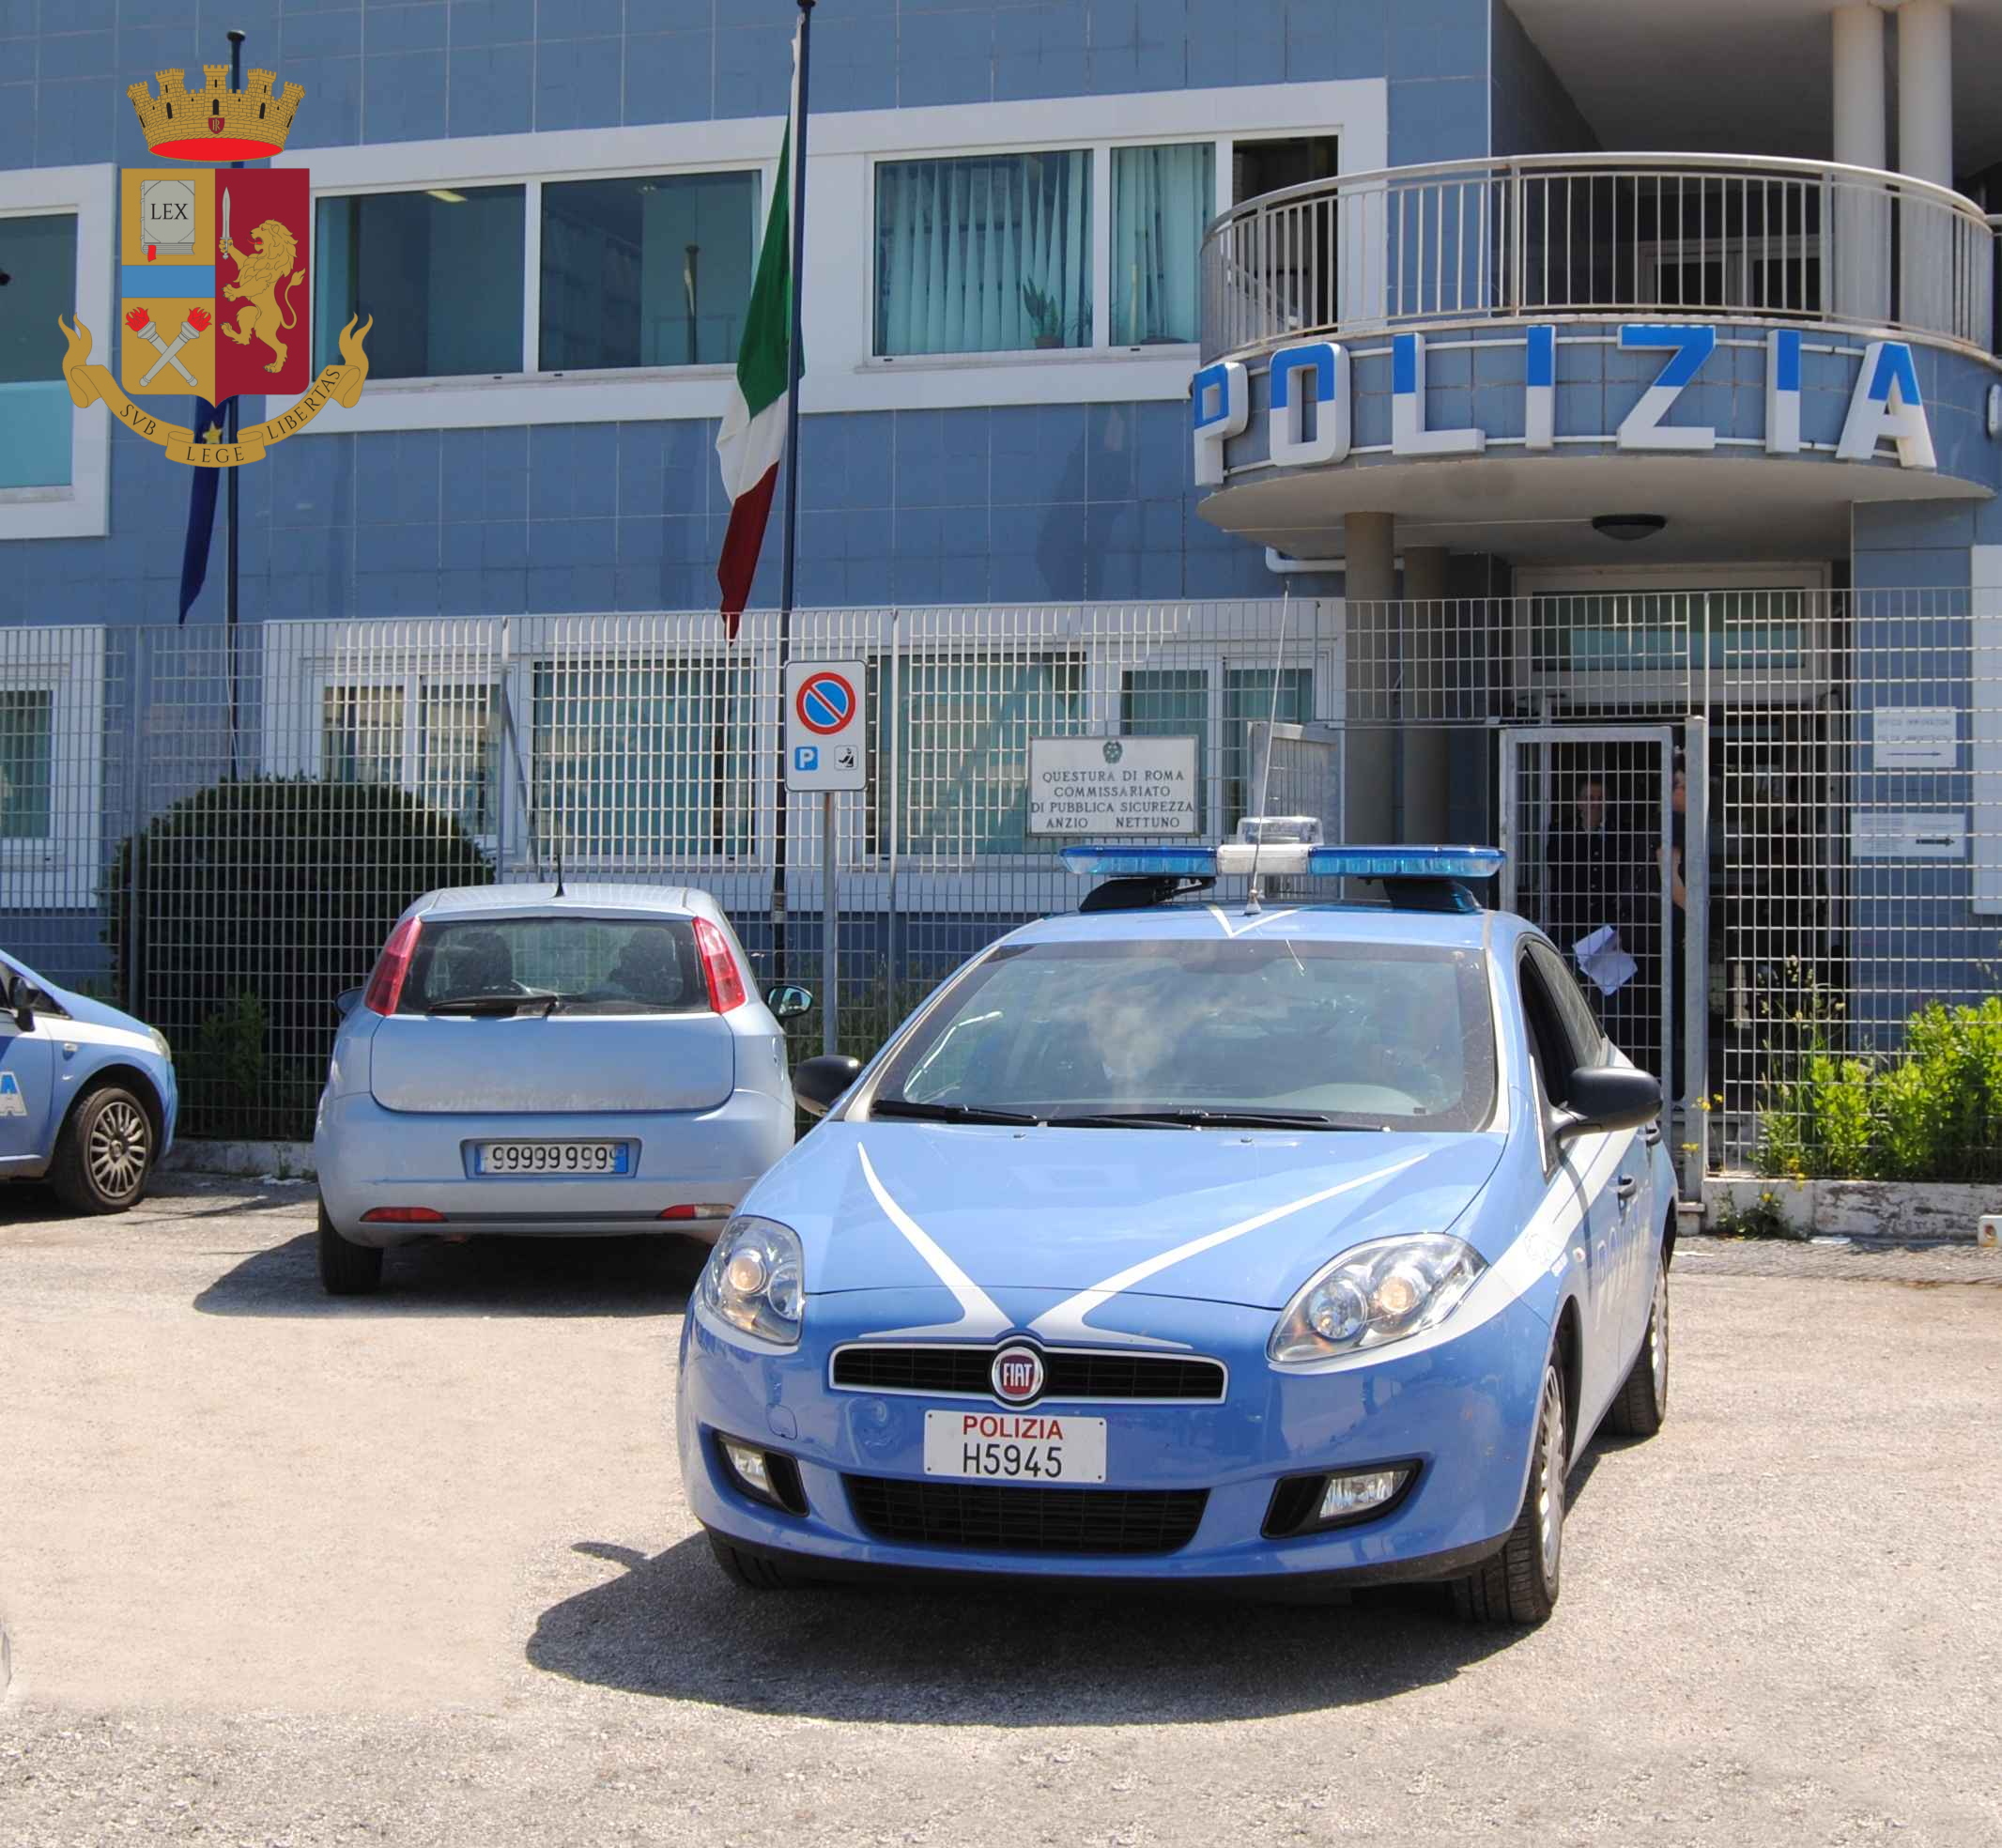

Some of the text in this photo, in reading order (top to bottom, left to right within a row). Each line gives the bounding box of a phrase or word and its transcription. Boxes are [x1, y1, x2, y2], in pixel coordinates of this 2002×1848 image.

[1193, 324, 1938, 486] POLIZIA
[799, 748, 815, 768] P
[1042, 770, 1184, 783] QUESTURA DI ROMA
[1054, 786, 1171, 797] COMMISSARIATO
[1031, 801, 1194, 813] DI PUBBLICA SICUREZZA
[1046, 816, 1180, 828] ANZIO NETTUNO
[1003, 1363, 1033, 1387] FIAT
[962, 1415, 1064, 1440] POLIZIA
[962, 1442, 1062, 1478] H5945
